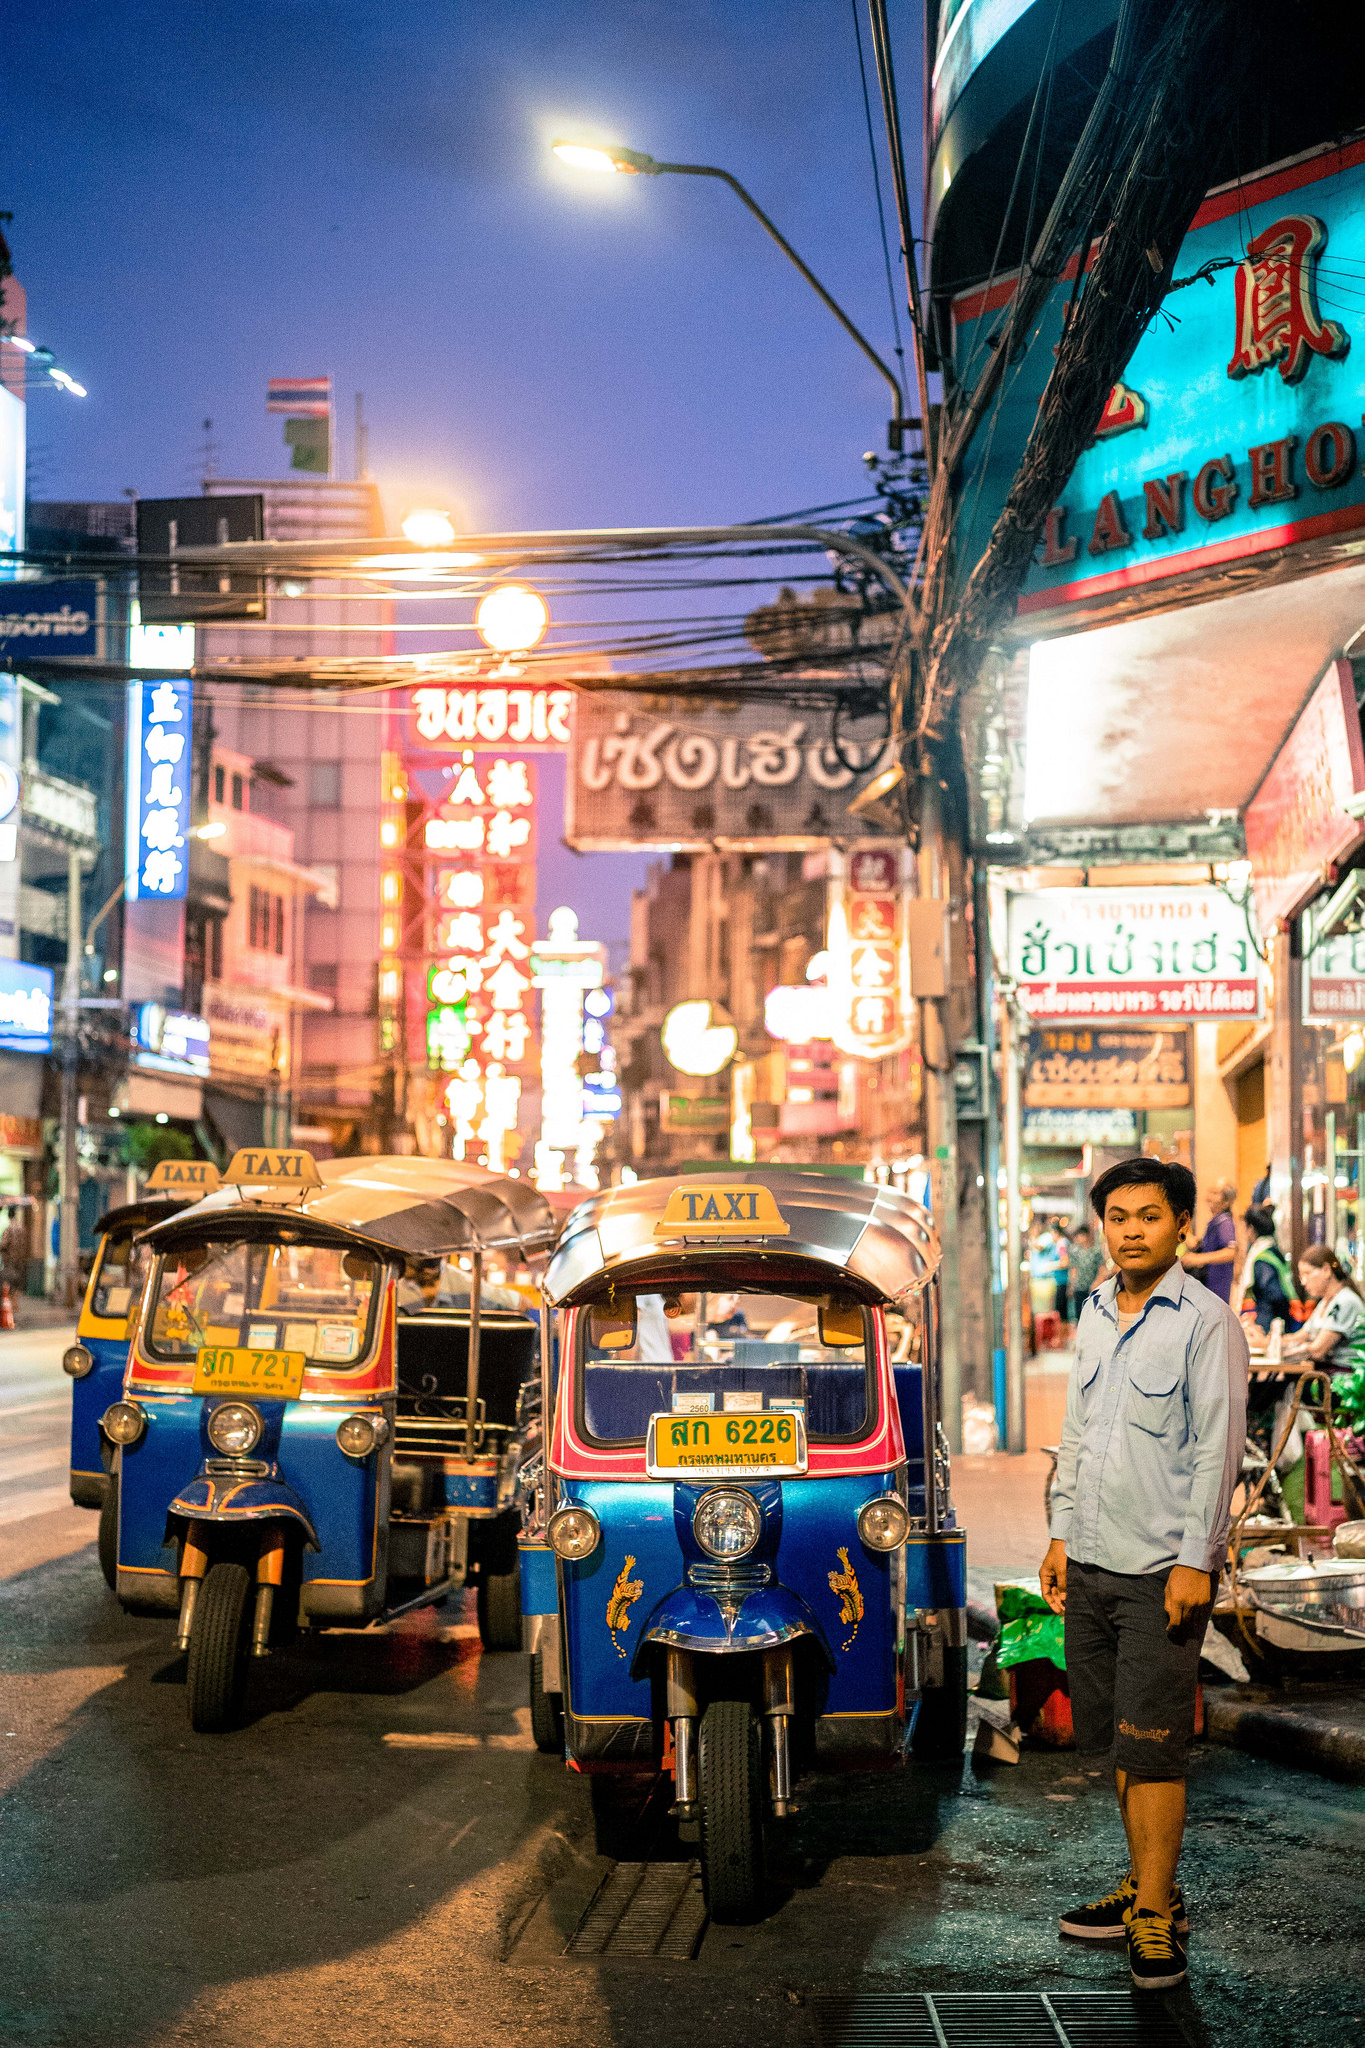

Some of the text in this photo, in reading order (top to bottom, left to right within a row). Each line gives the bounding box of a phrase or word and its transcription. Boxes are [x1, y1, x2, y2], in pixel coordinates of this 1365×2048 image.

[1040, 420, 1365, 568] LANGHO
[162, 1164, 206, 1183] TAXI
[242, 1153, 304, 1177] TAXI
[681, 1192, 760, 1221] TAXI
[251, 1352, 290, 1377] 721
[689, 1404, 710, 1413] 2560
[670, 1418, 792, 1446] สก 6226
